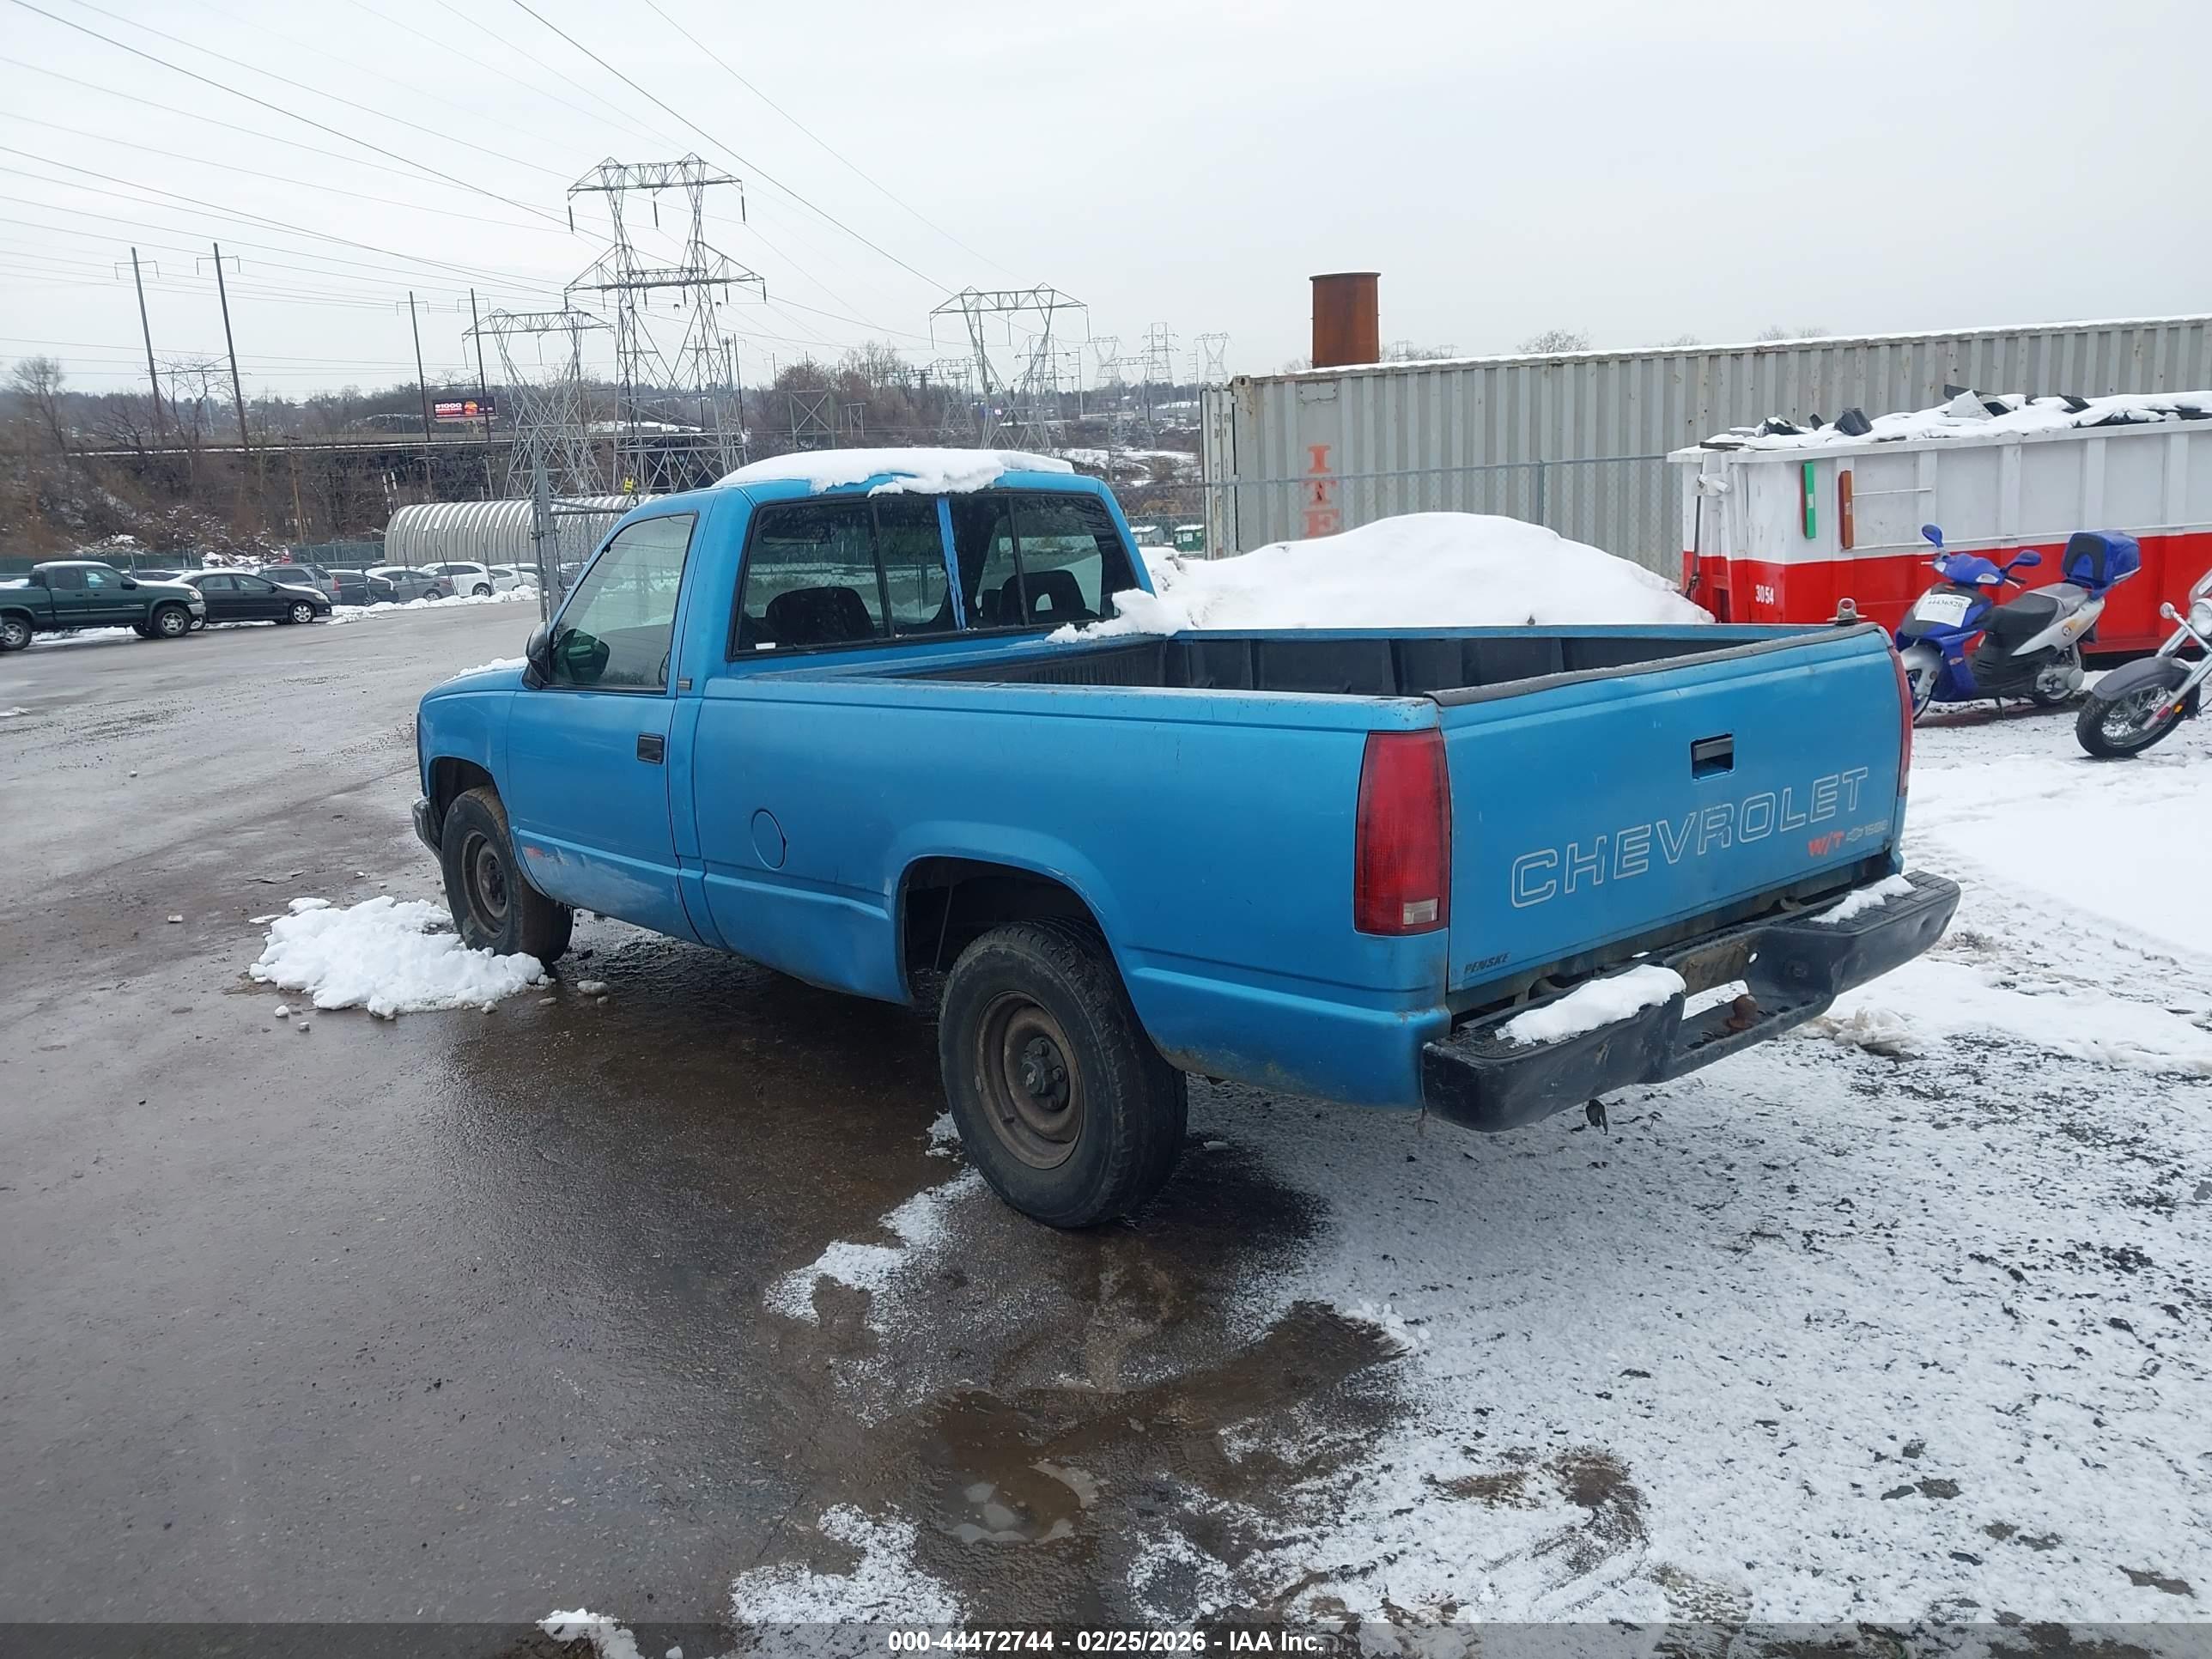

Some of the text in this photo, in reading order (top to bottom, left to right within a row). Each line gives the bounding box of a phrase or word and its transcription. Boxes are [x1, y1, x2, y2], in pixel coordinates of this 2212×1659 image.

[1754, 584, 1775, 605] 3054
[1510, 767, 1869, 908] CHEVROLET
[1808, 830, 1844, 857] W/T
[1463, 951, 1511, 975] PENSKE
